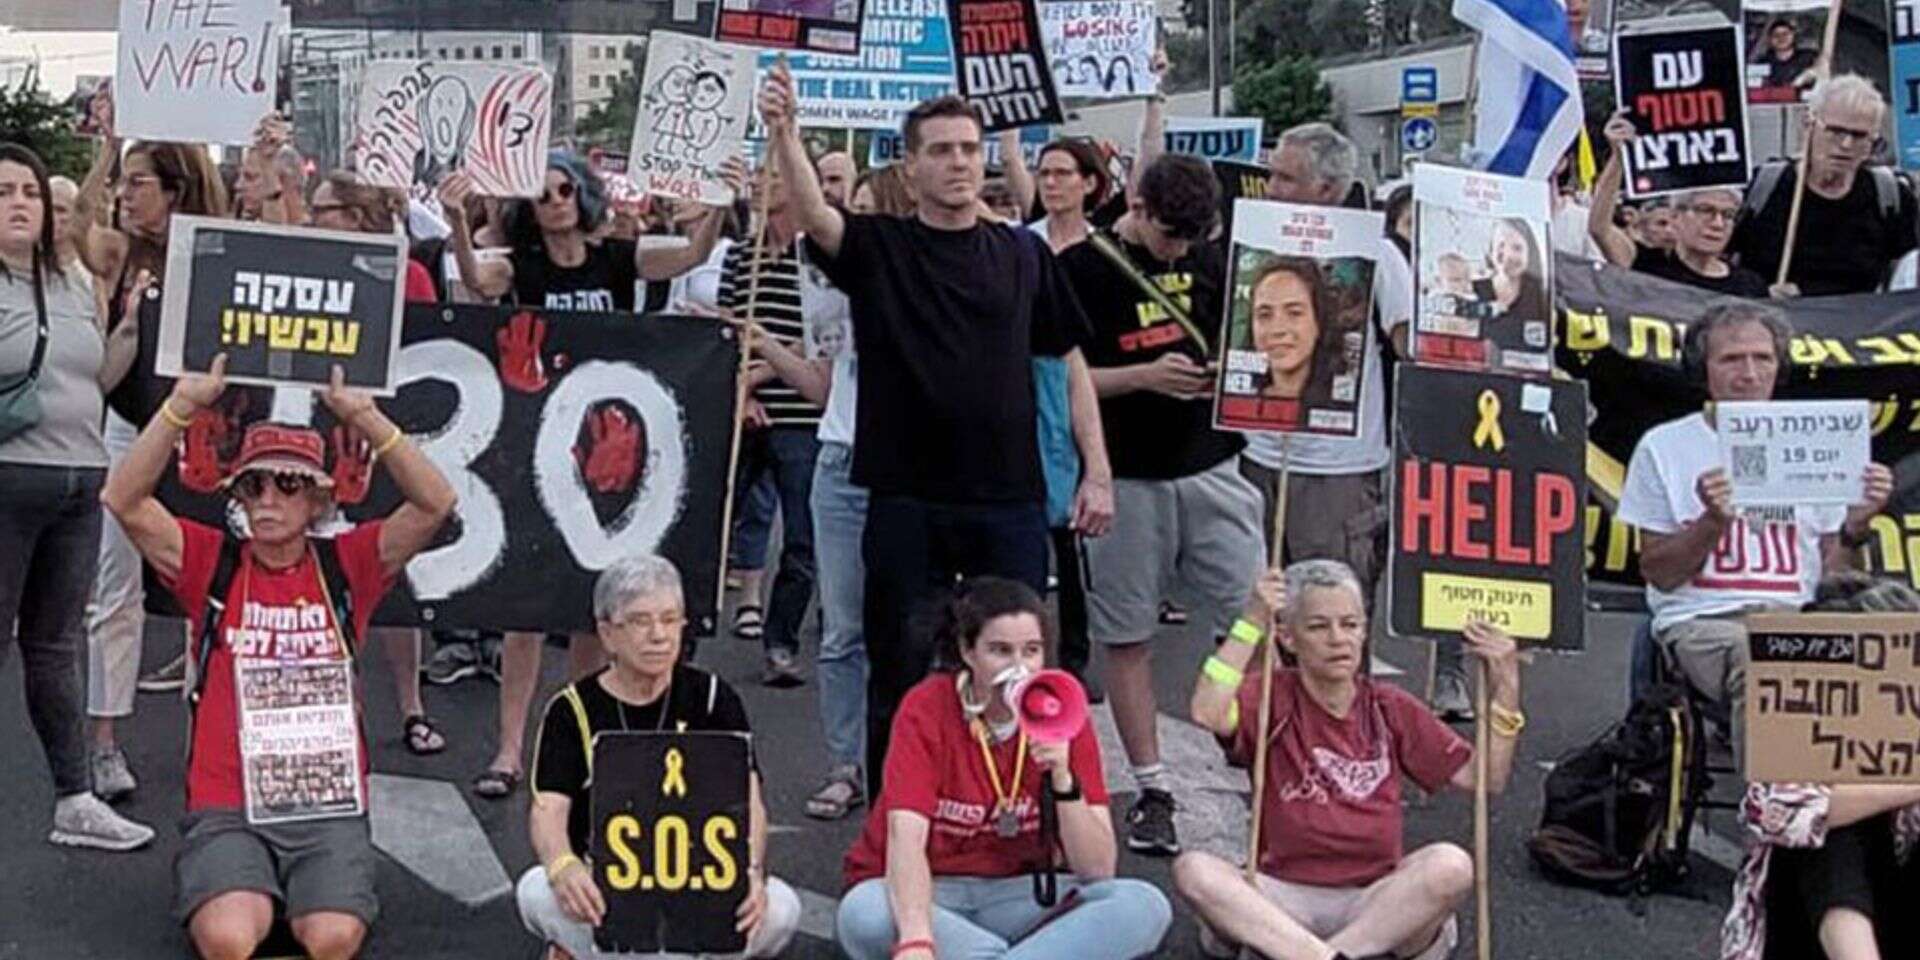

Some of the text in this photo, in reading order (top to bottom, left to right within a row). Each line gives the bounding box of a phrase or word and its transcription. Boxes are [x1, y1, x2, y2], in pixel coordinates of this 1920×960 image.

[142, 0, 240, 32] THE
[1063, 20, 1139, 38] LOSING
[961, 20, 1029, 54] ויתרה
[132, 21, 272, 94] WAR!
[964, 52, 1042, 96] העם
[1653, 50, 1704, 89] עם
[799, 106, 842, 119] OMEN
[968, 89, 1048, 127] יחזיר
[1637, 89, 1726, 132] חטוף
[1634, 128, 1740, 171] בארצו
[234, 270, 355, 315] עסקה
[221, 308, 360, 355] עכשיו!
[1781, 411, 1863, 434] שביתת
[1812, 447, 1841, 463] יום
[1402, 459, 1576, 566] HELP
[1712, 508, 1800, 576] עכש
[1441, 585, 1533, 607] תינוק חטוף
[1467, 608, 1511, 626] בעזה
[1758, 678, 1860, 716] וחובה
[1812, 721, 1920, 776] הציל
[606, 814, 738, 891] S.O.S
